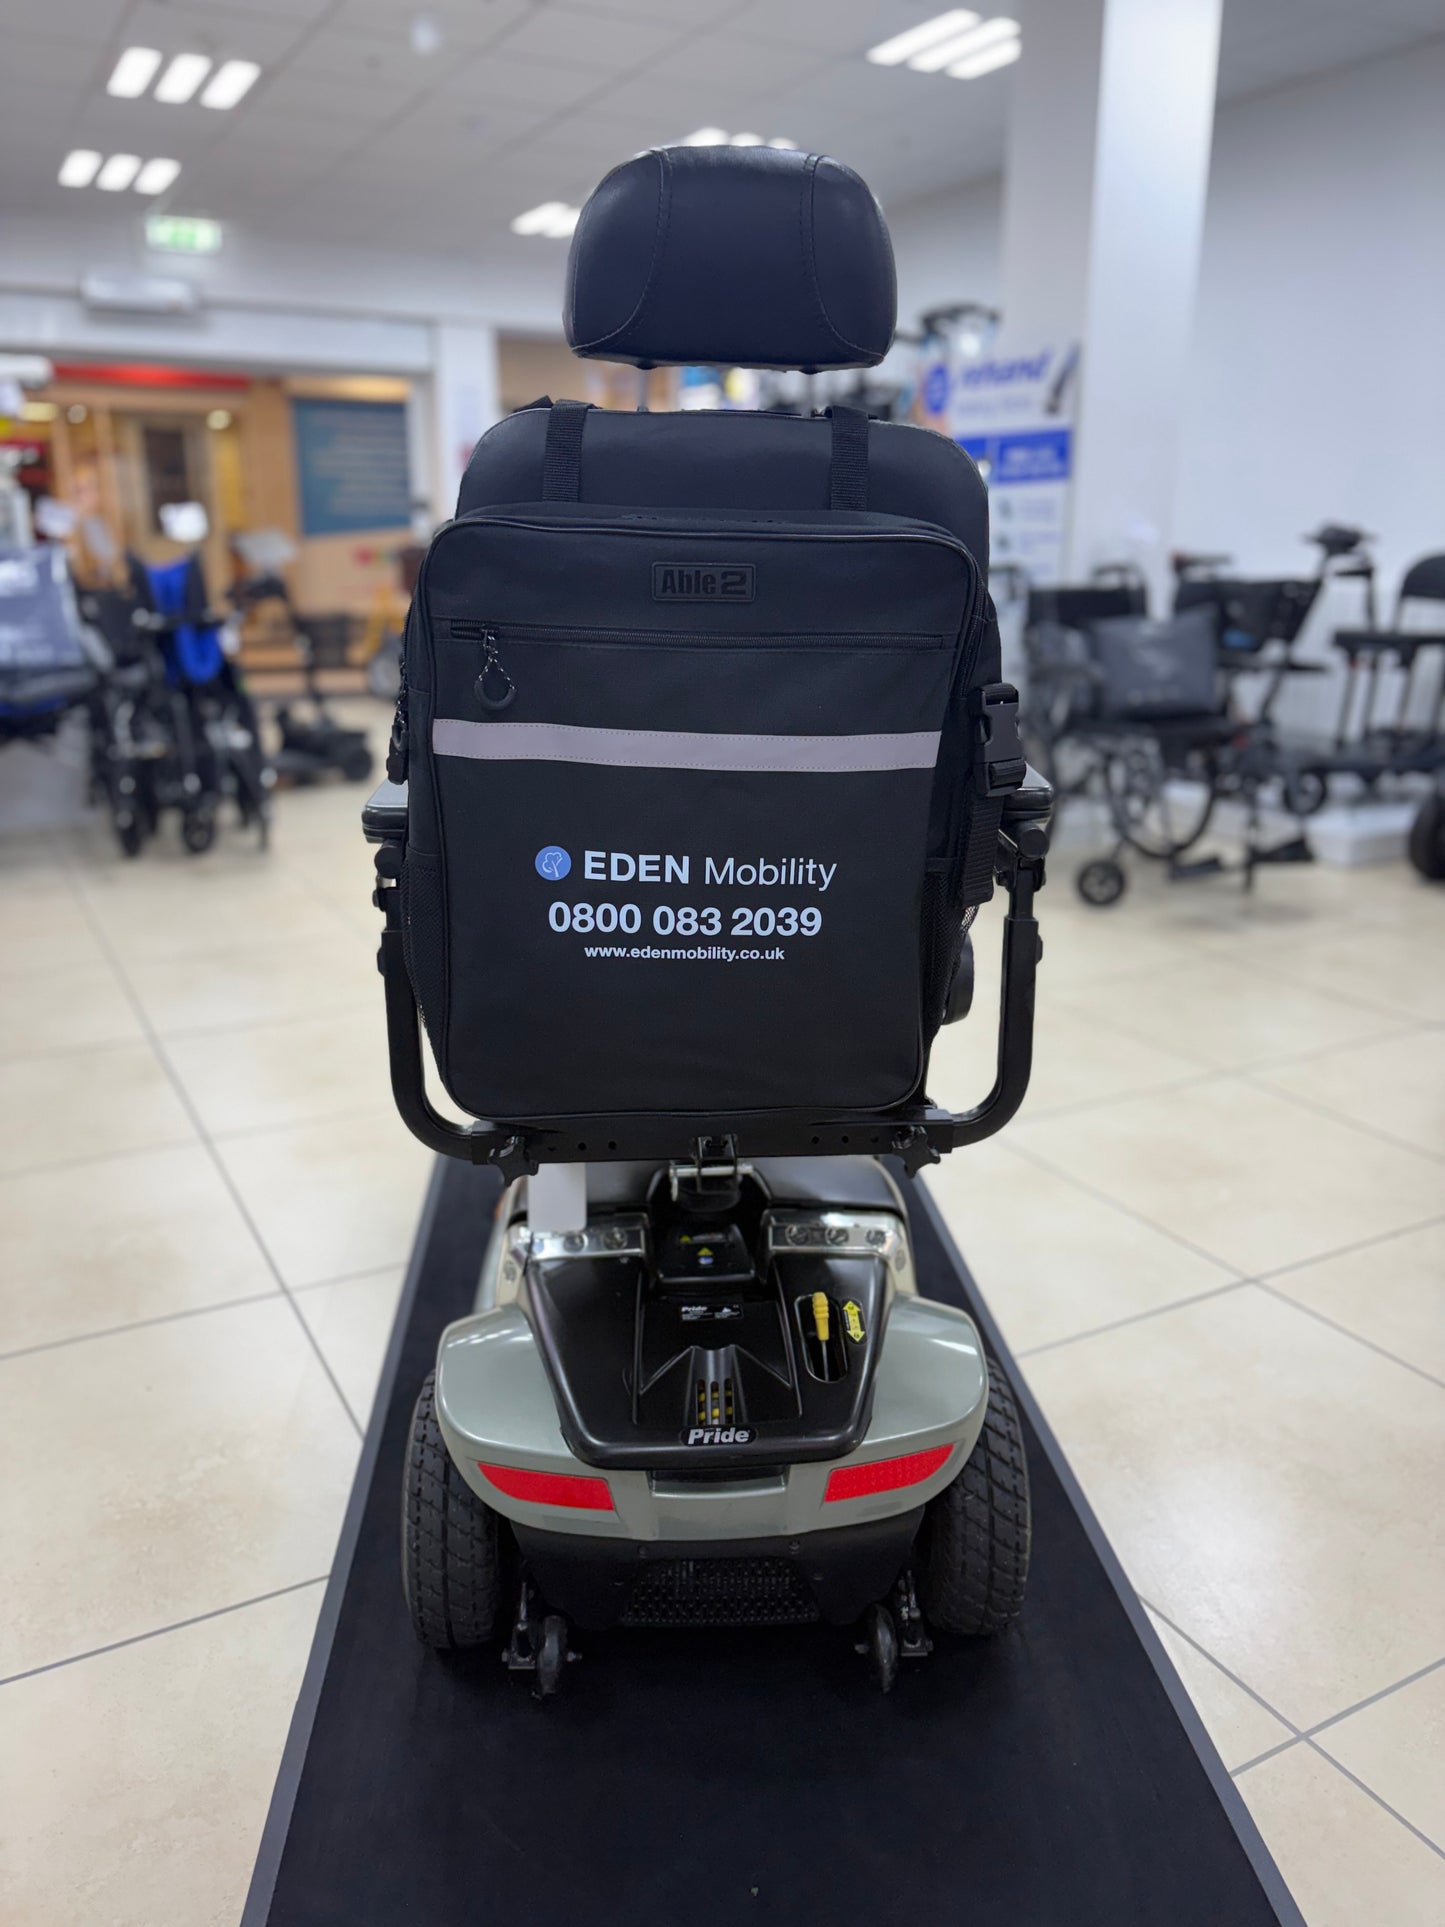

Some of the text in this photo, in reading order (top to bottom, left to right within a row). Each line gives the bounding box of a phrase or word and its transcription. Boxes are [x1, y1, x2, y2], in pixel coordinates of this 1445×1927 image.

[584, 850, 838, 892] EDEN Mobility
[548, 901, 823, 937] 0800 083 2039
[584, 945, 785, 962] www.edenmobility.co.uk
[688, 1427, 749, 1445] Pride
